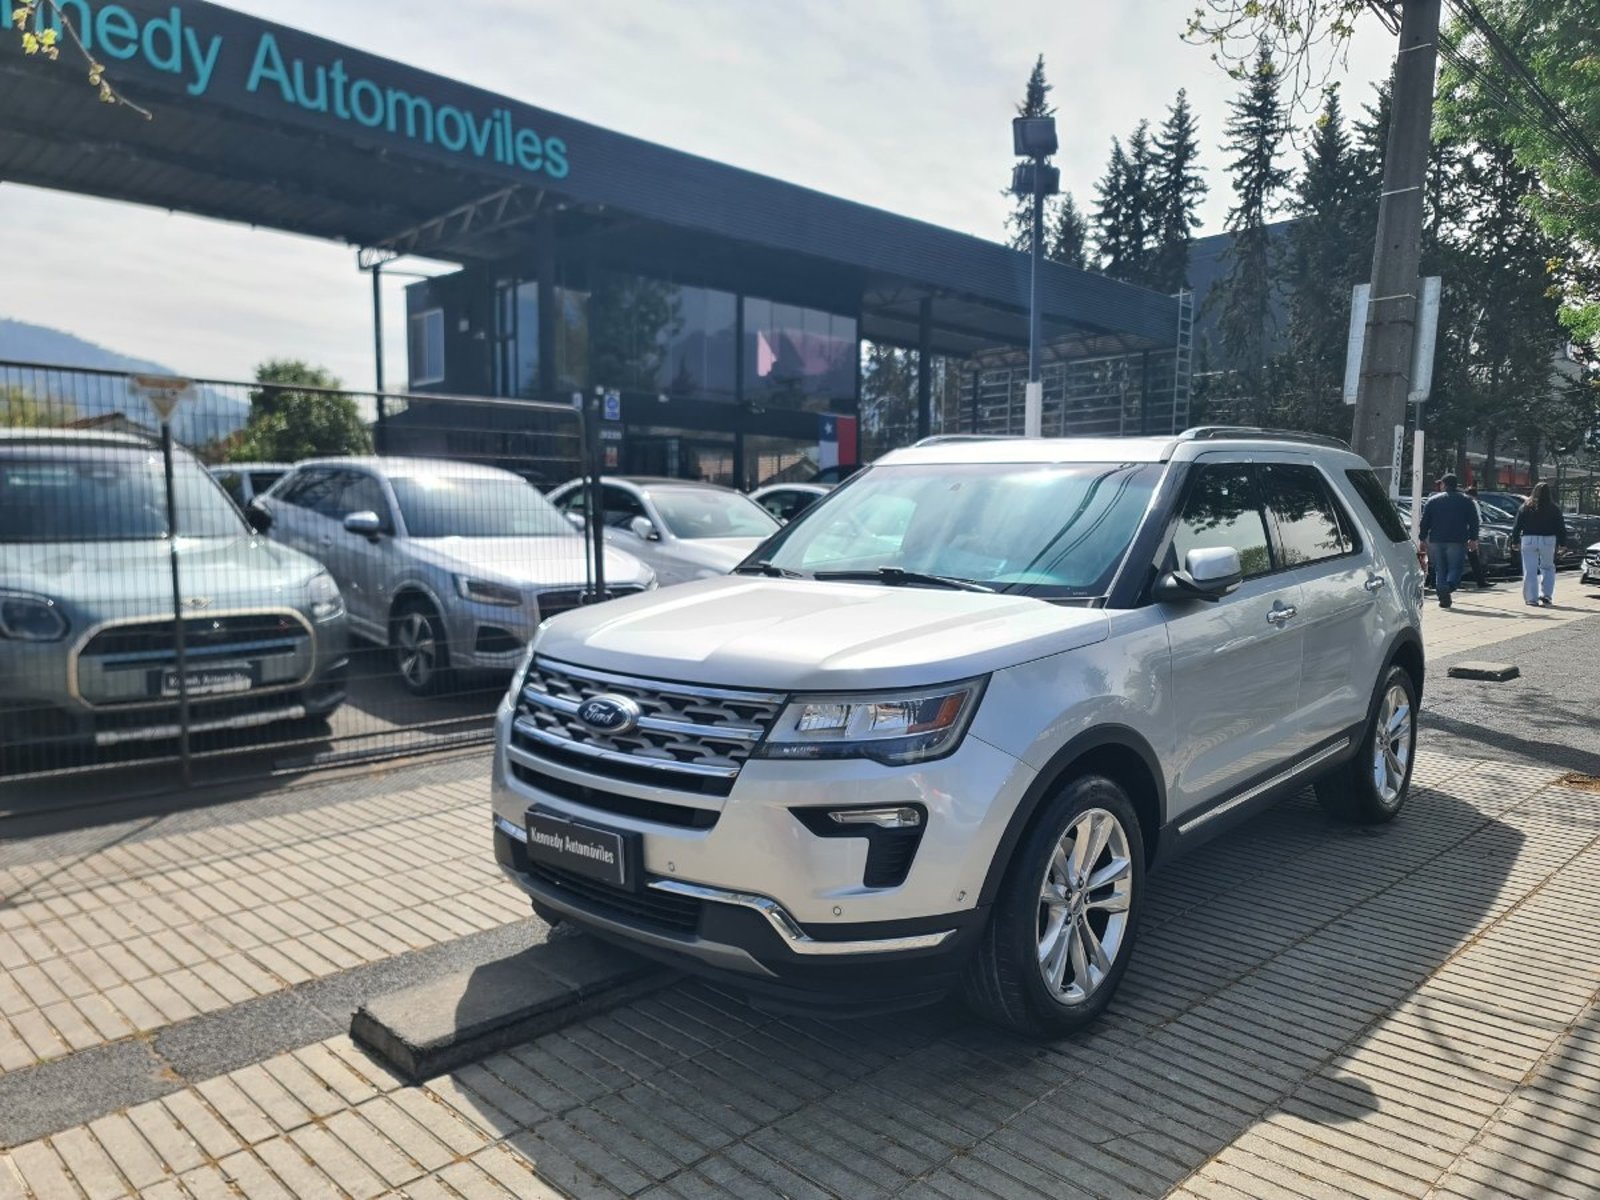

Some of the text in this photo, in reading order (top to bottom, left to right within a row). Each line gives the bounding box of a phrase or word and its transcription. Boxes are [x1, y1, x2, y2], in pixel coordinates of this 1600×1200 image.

[246, 33, 569, 178] Automoviles
[583, 702, 615, 724] Ford
[530, 826, 614, 864] Kennedy Automóviles
